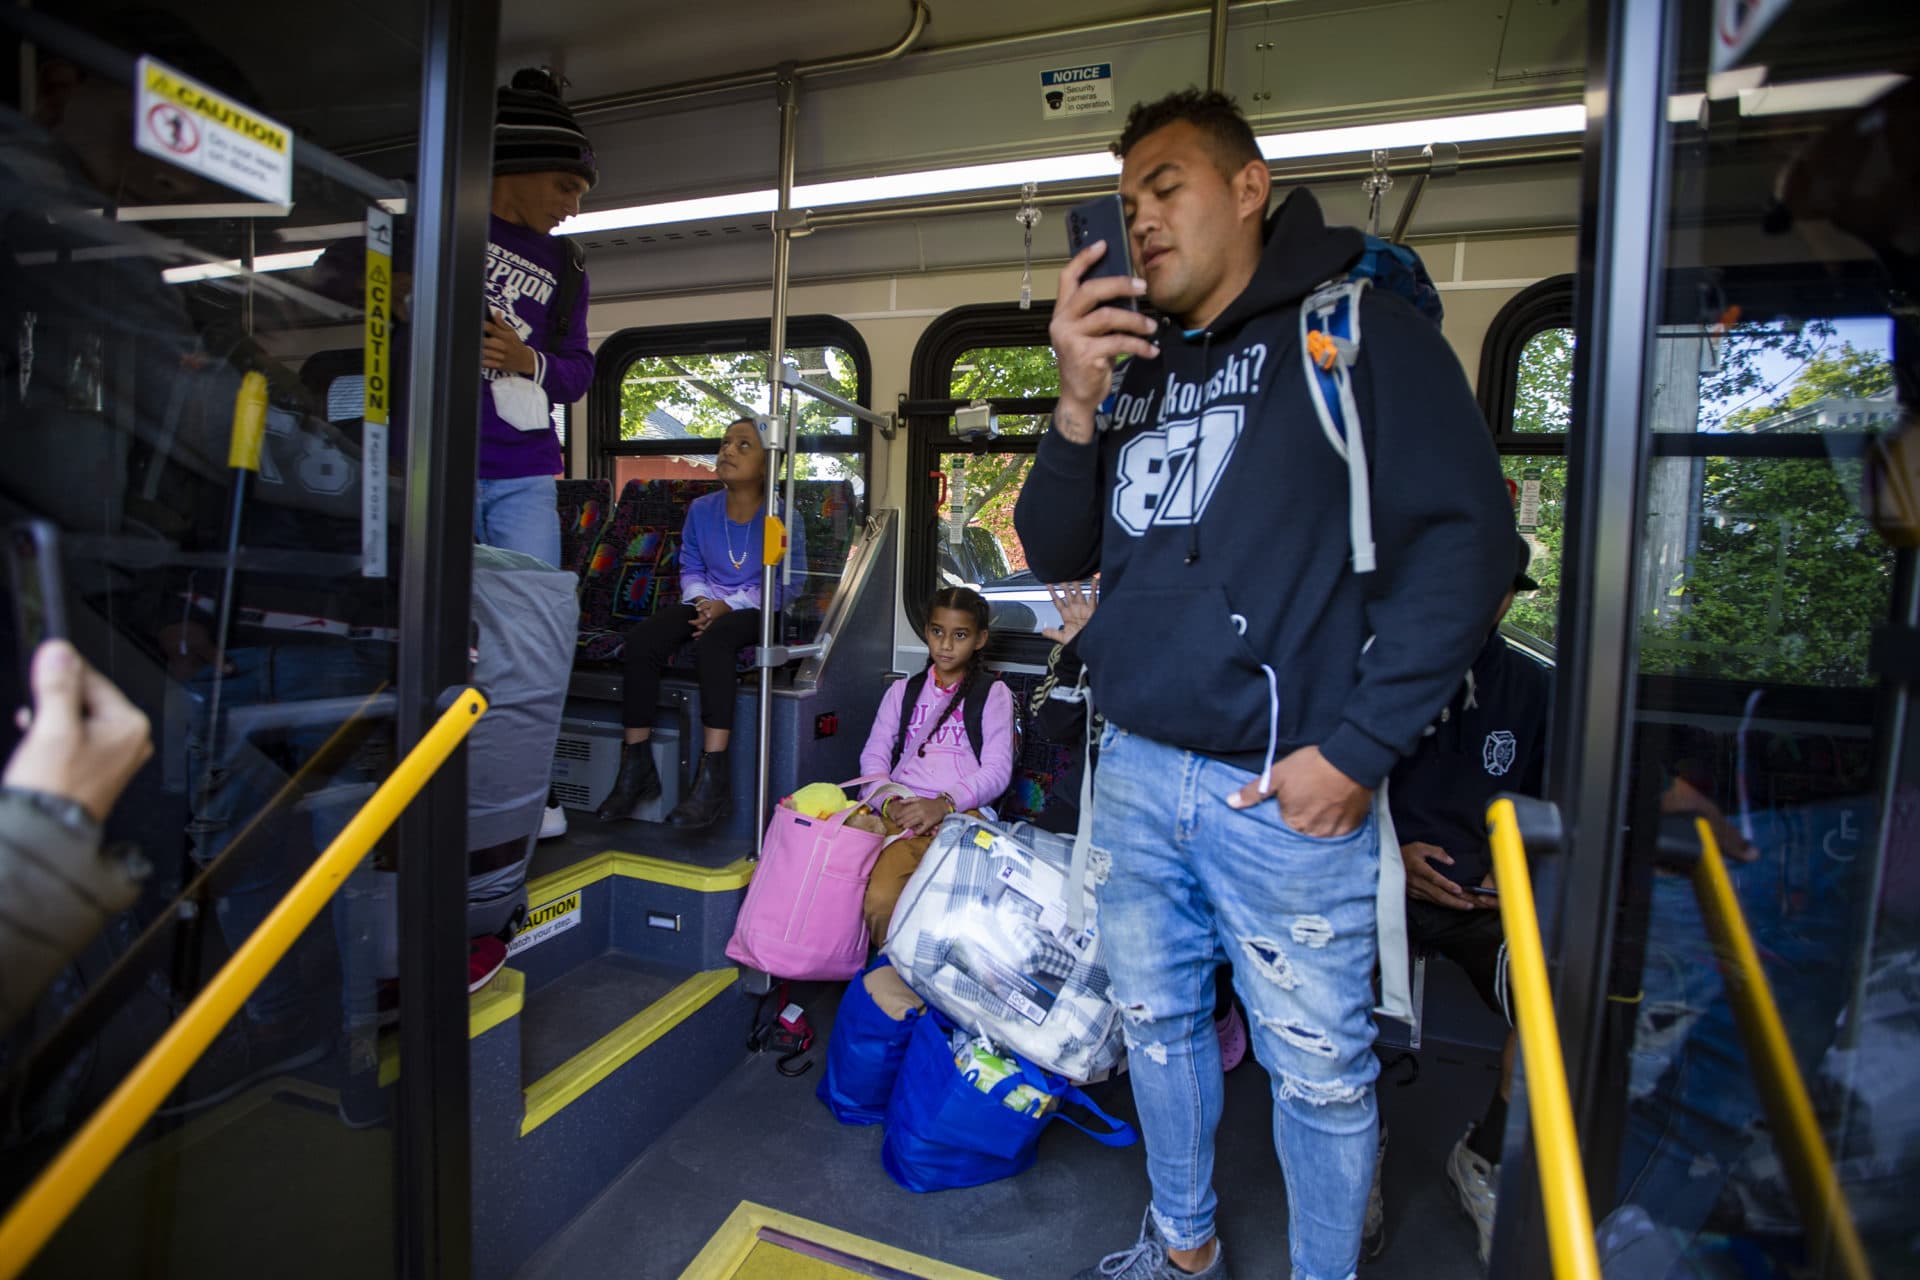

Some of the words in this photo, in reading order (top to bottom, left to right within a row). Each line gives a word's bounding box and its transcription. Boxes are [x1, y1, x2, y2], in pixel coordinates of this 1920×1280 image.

[1053, 67, 1101, 83] NOTICE
[1066, 85, 1096, 94] Security
[1067, 93, 1097, 103] cameras
[1068, 103, 1075, 111] in
[177, 87, 284, 150] CAUTION
[369, 287, 385, 410] CAUTION
[1112, 386, 1155, 431] got
[1112, 404, 1246, 537] 87
[516, 896, 576, 934] AUTION
